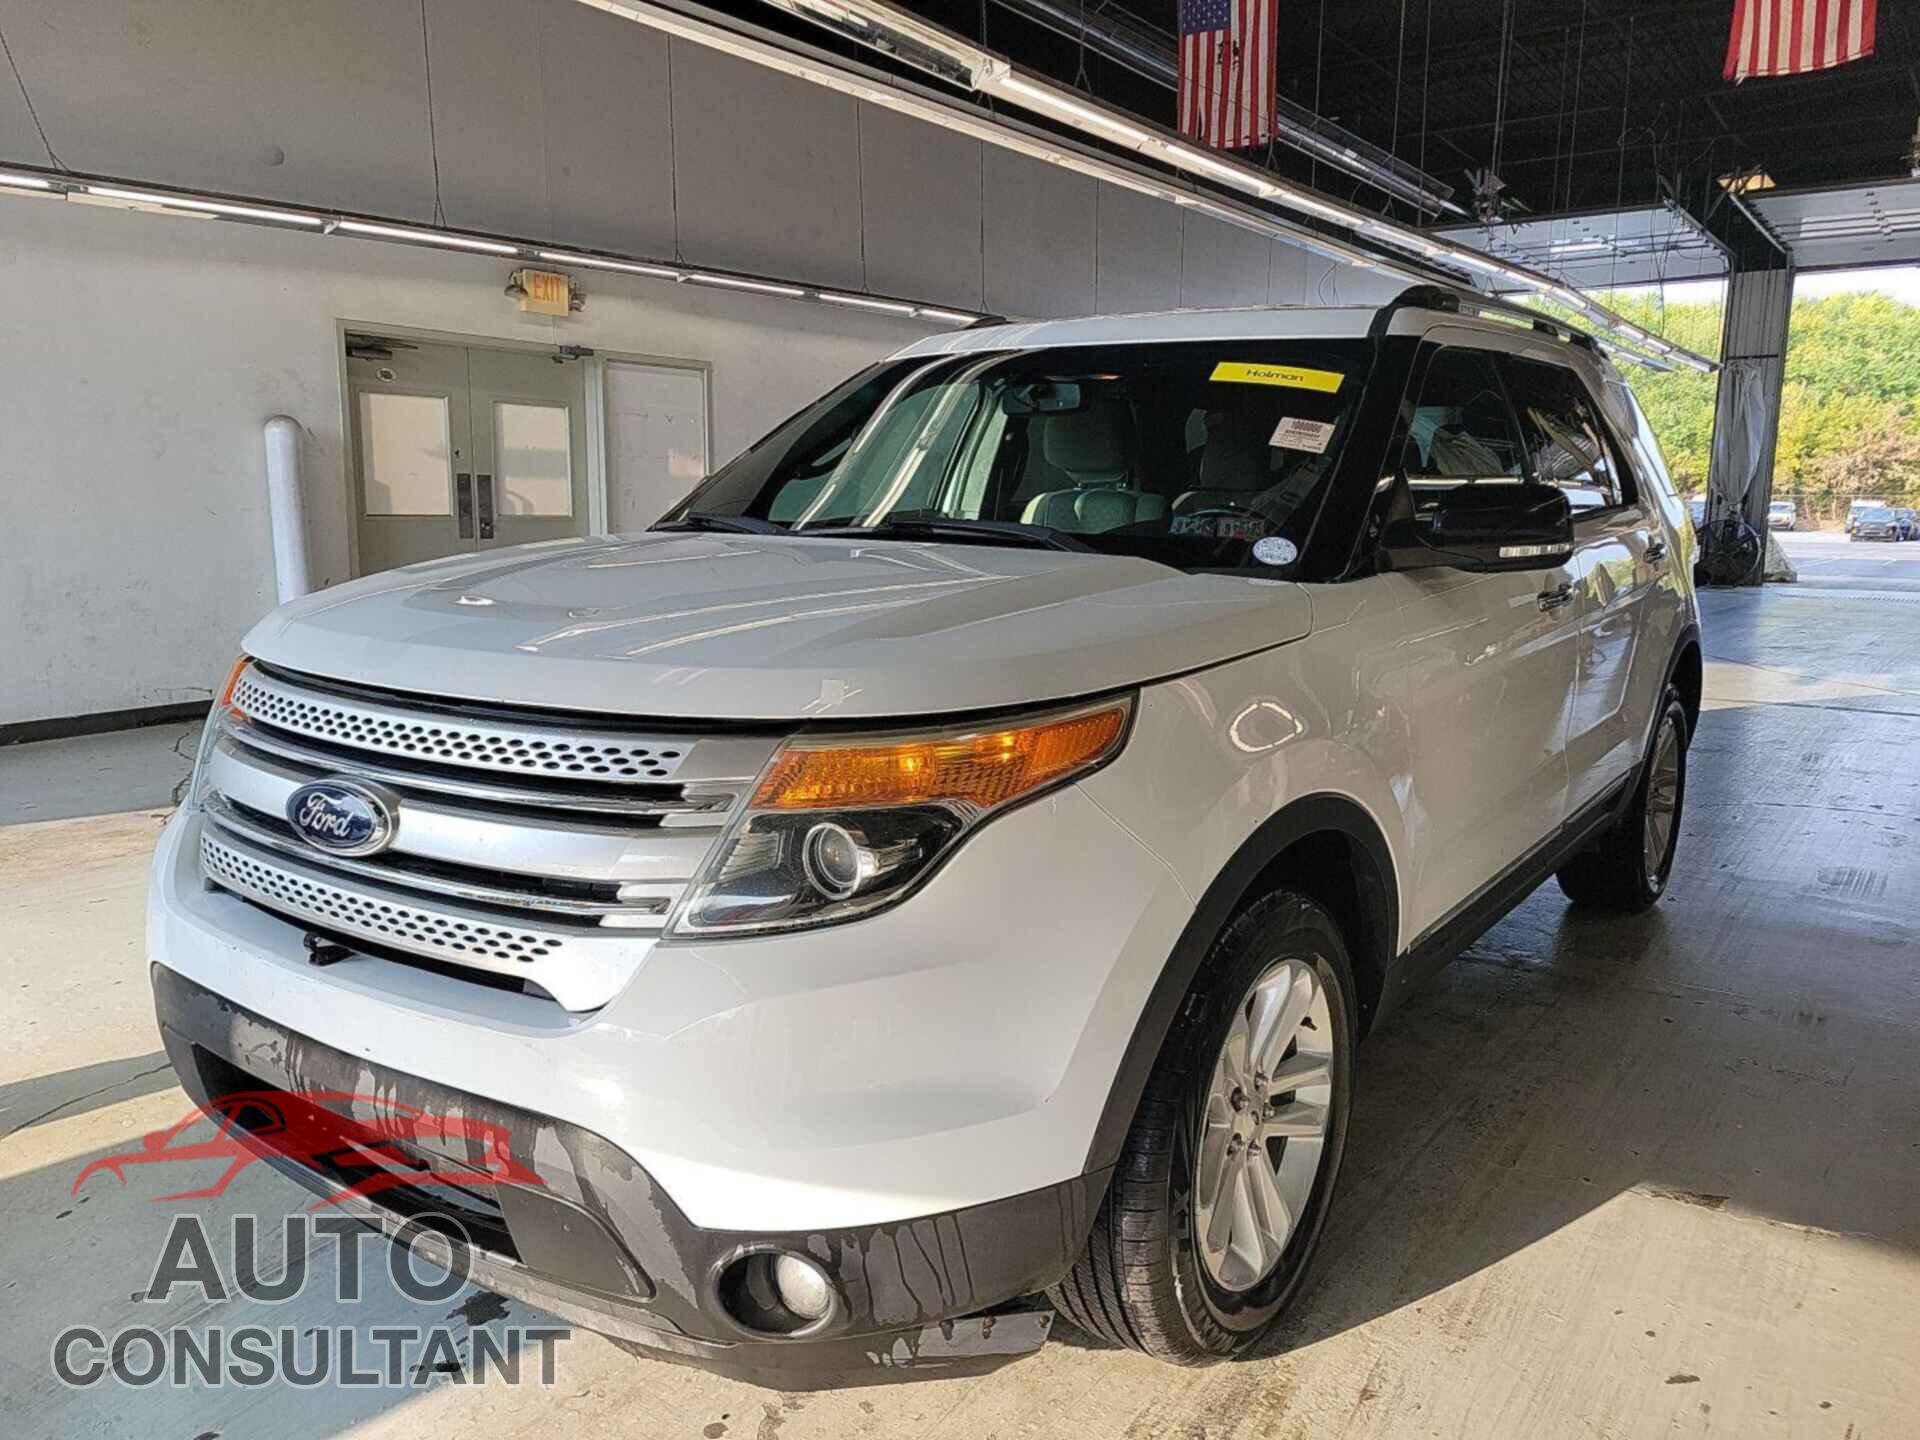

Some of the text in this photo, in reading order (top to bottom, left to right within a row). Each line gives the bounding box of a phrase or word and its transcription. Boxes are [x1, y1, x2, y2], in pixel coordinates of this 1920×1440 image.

[534, 272, 561, 301] EXIT
[1245, 369, 1304, 382] Holman
[299, 792, 355, 837] Ford
